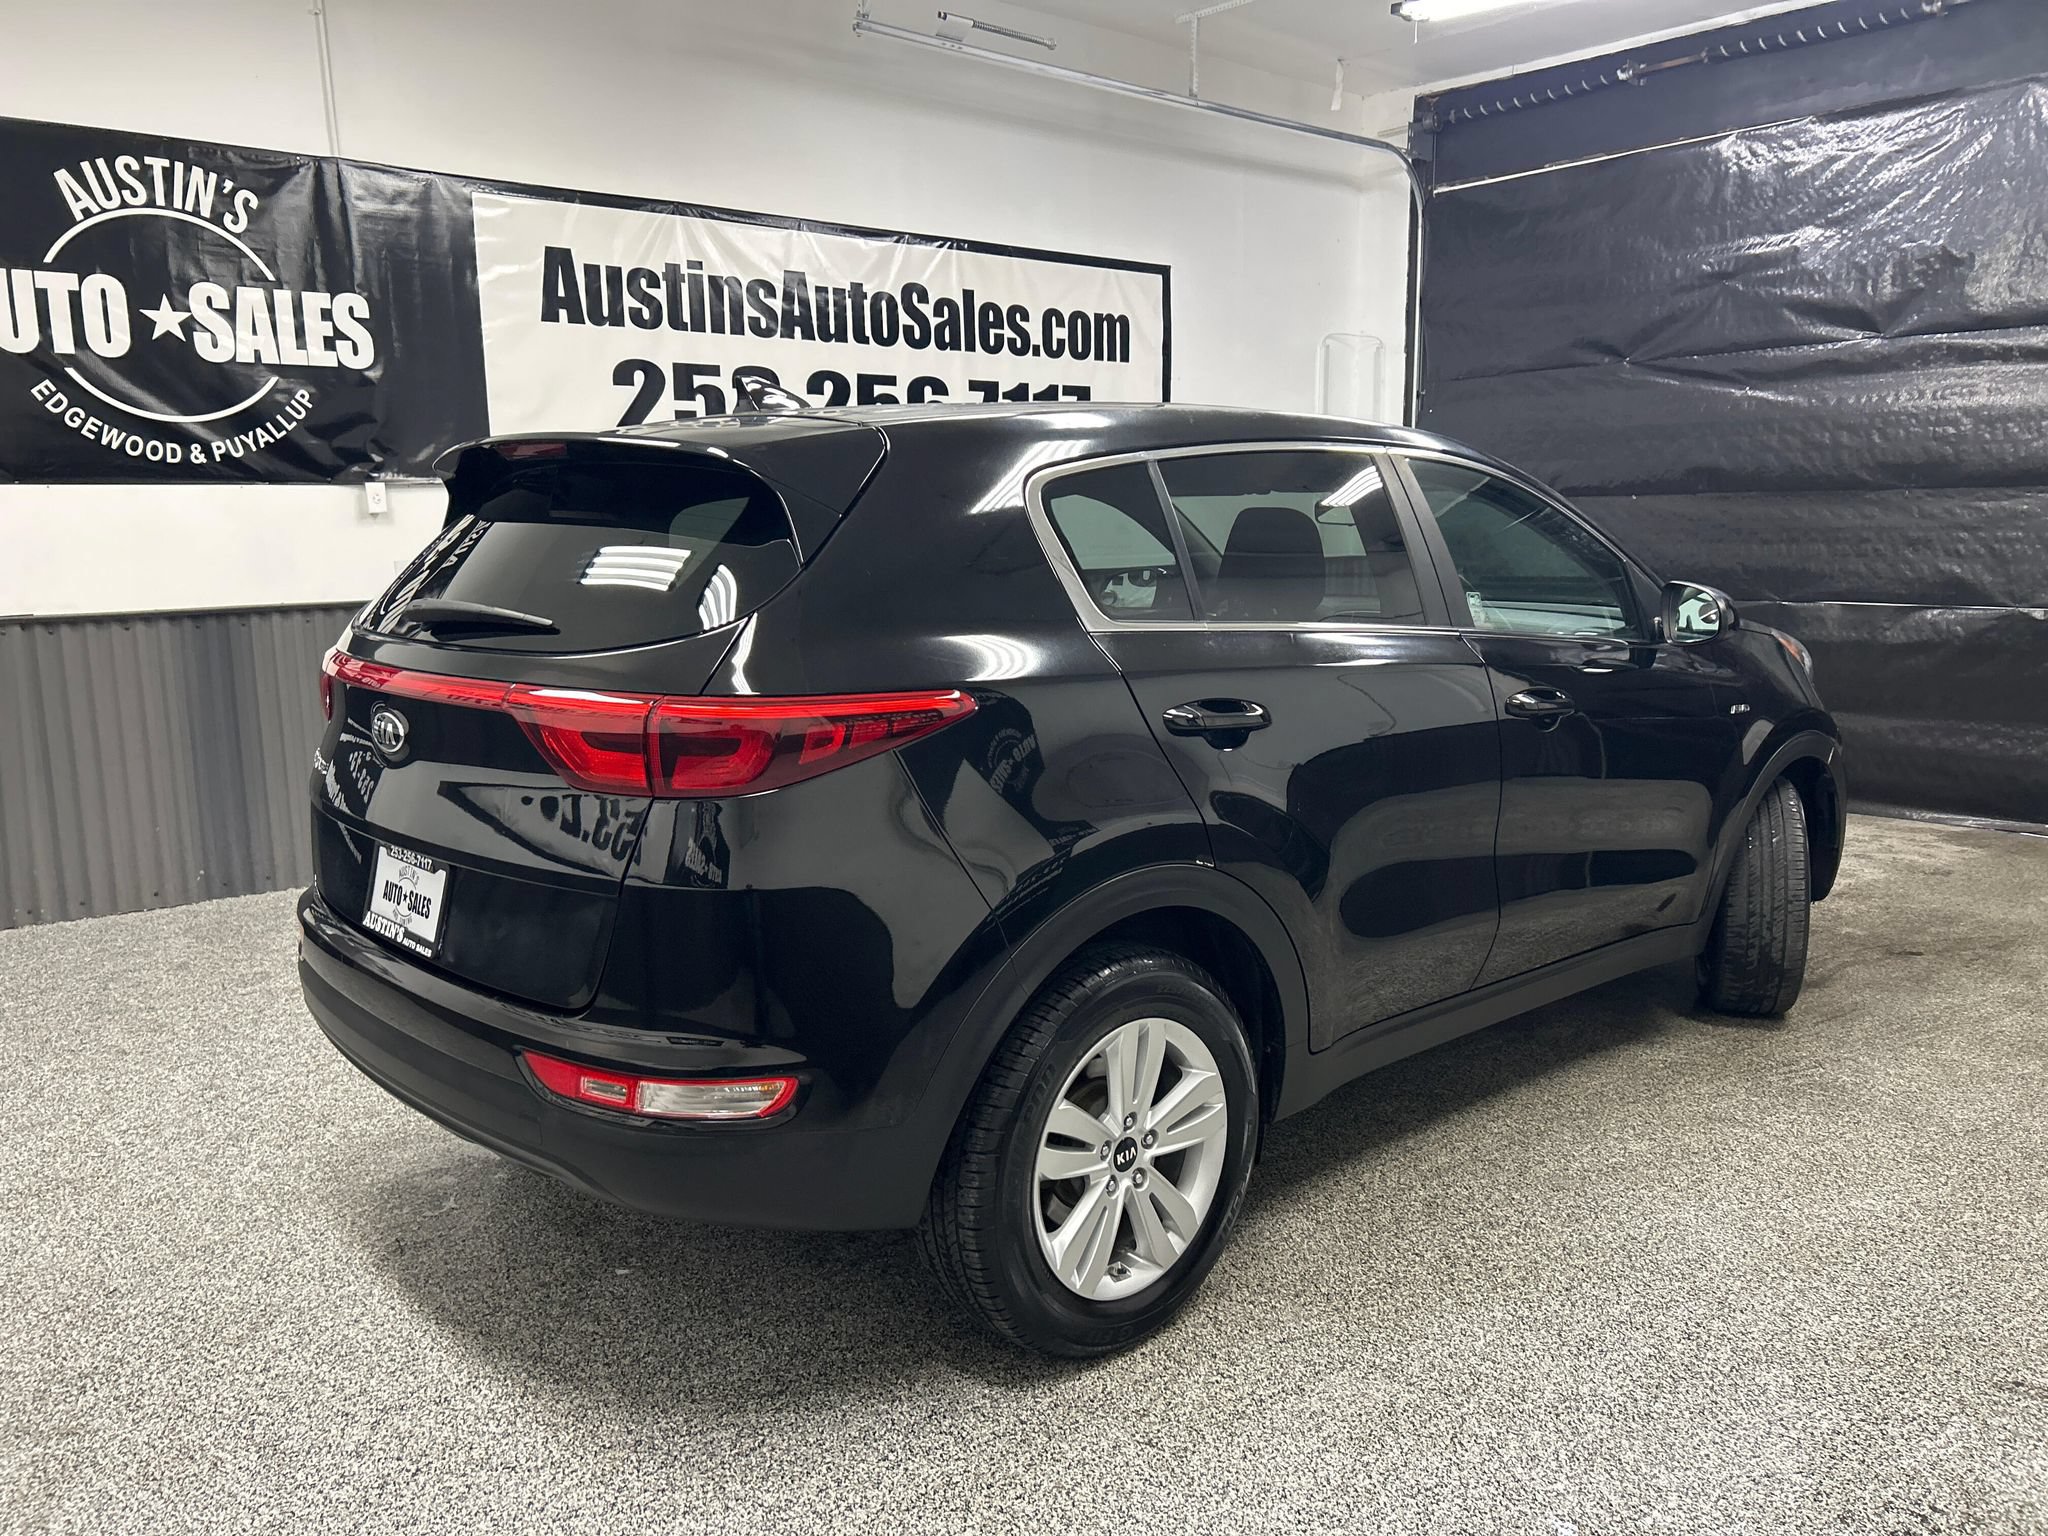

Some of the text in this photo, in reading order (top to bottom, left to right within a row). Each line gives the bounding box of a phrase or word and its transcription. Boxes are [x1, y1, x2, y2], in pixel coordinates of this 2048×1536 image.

[54, 155, 258, 234] AUSTIN'S
[0, 268, 375, 369] UTO SALES
[541, 246, 1130, 363] AustinsAutoSales.com
[30, 379, 313, 464] EDGEWOOD & PUYALLUP
[390, 845, 432, 870] 253-256-7117
[383, 880, 402, 906] AUTO
[408, 890, 431, 919] SALES
[362, 911, 405, 942] AUSTIN'S
[402, 939, 415, 950] AUTO
[416, 944, 432, 957] SALES
[1116, 1147, 1137, 1165] KIA
